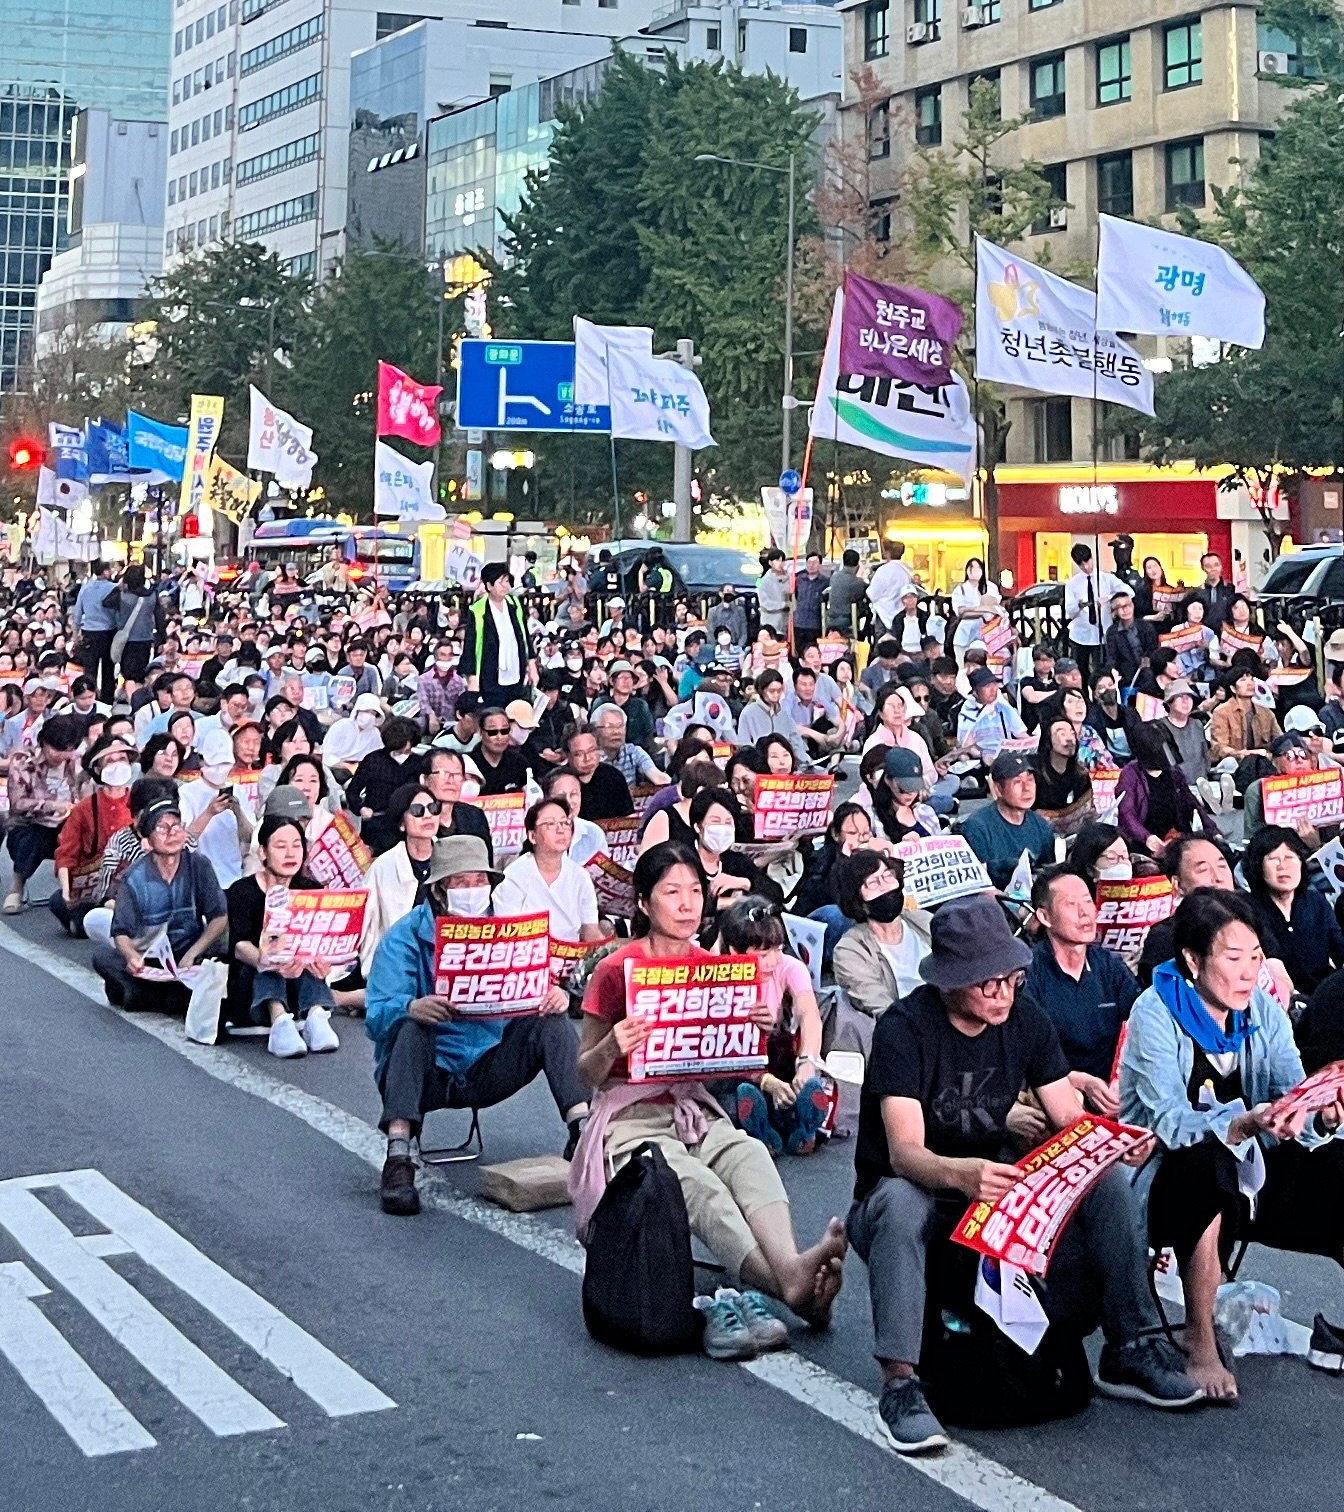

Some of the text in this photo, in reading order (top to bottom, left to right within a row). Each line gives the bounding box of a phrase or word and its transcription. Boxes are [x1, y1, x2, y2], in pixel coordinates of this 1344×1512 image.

[1155, 265, 1205, 296] 광명
[876, 299, 926, 330] 천주교
[859, 328, 944, 366] 더나은세상
[1000, 327, 1142, 386] 청년촛불행동
[441, 924, 495, 940] 국정농단
[441, 936, 548, 971] 윤건희정권
[633, 963, 756, 984] 국정농단 사기꾼집단
[635, 985, 758, 1022] 윤건희정권
[646, 1023, 761, 1062] 타도하자!
[982, 1125, 1114, 1252] 윤건희정권
